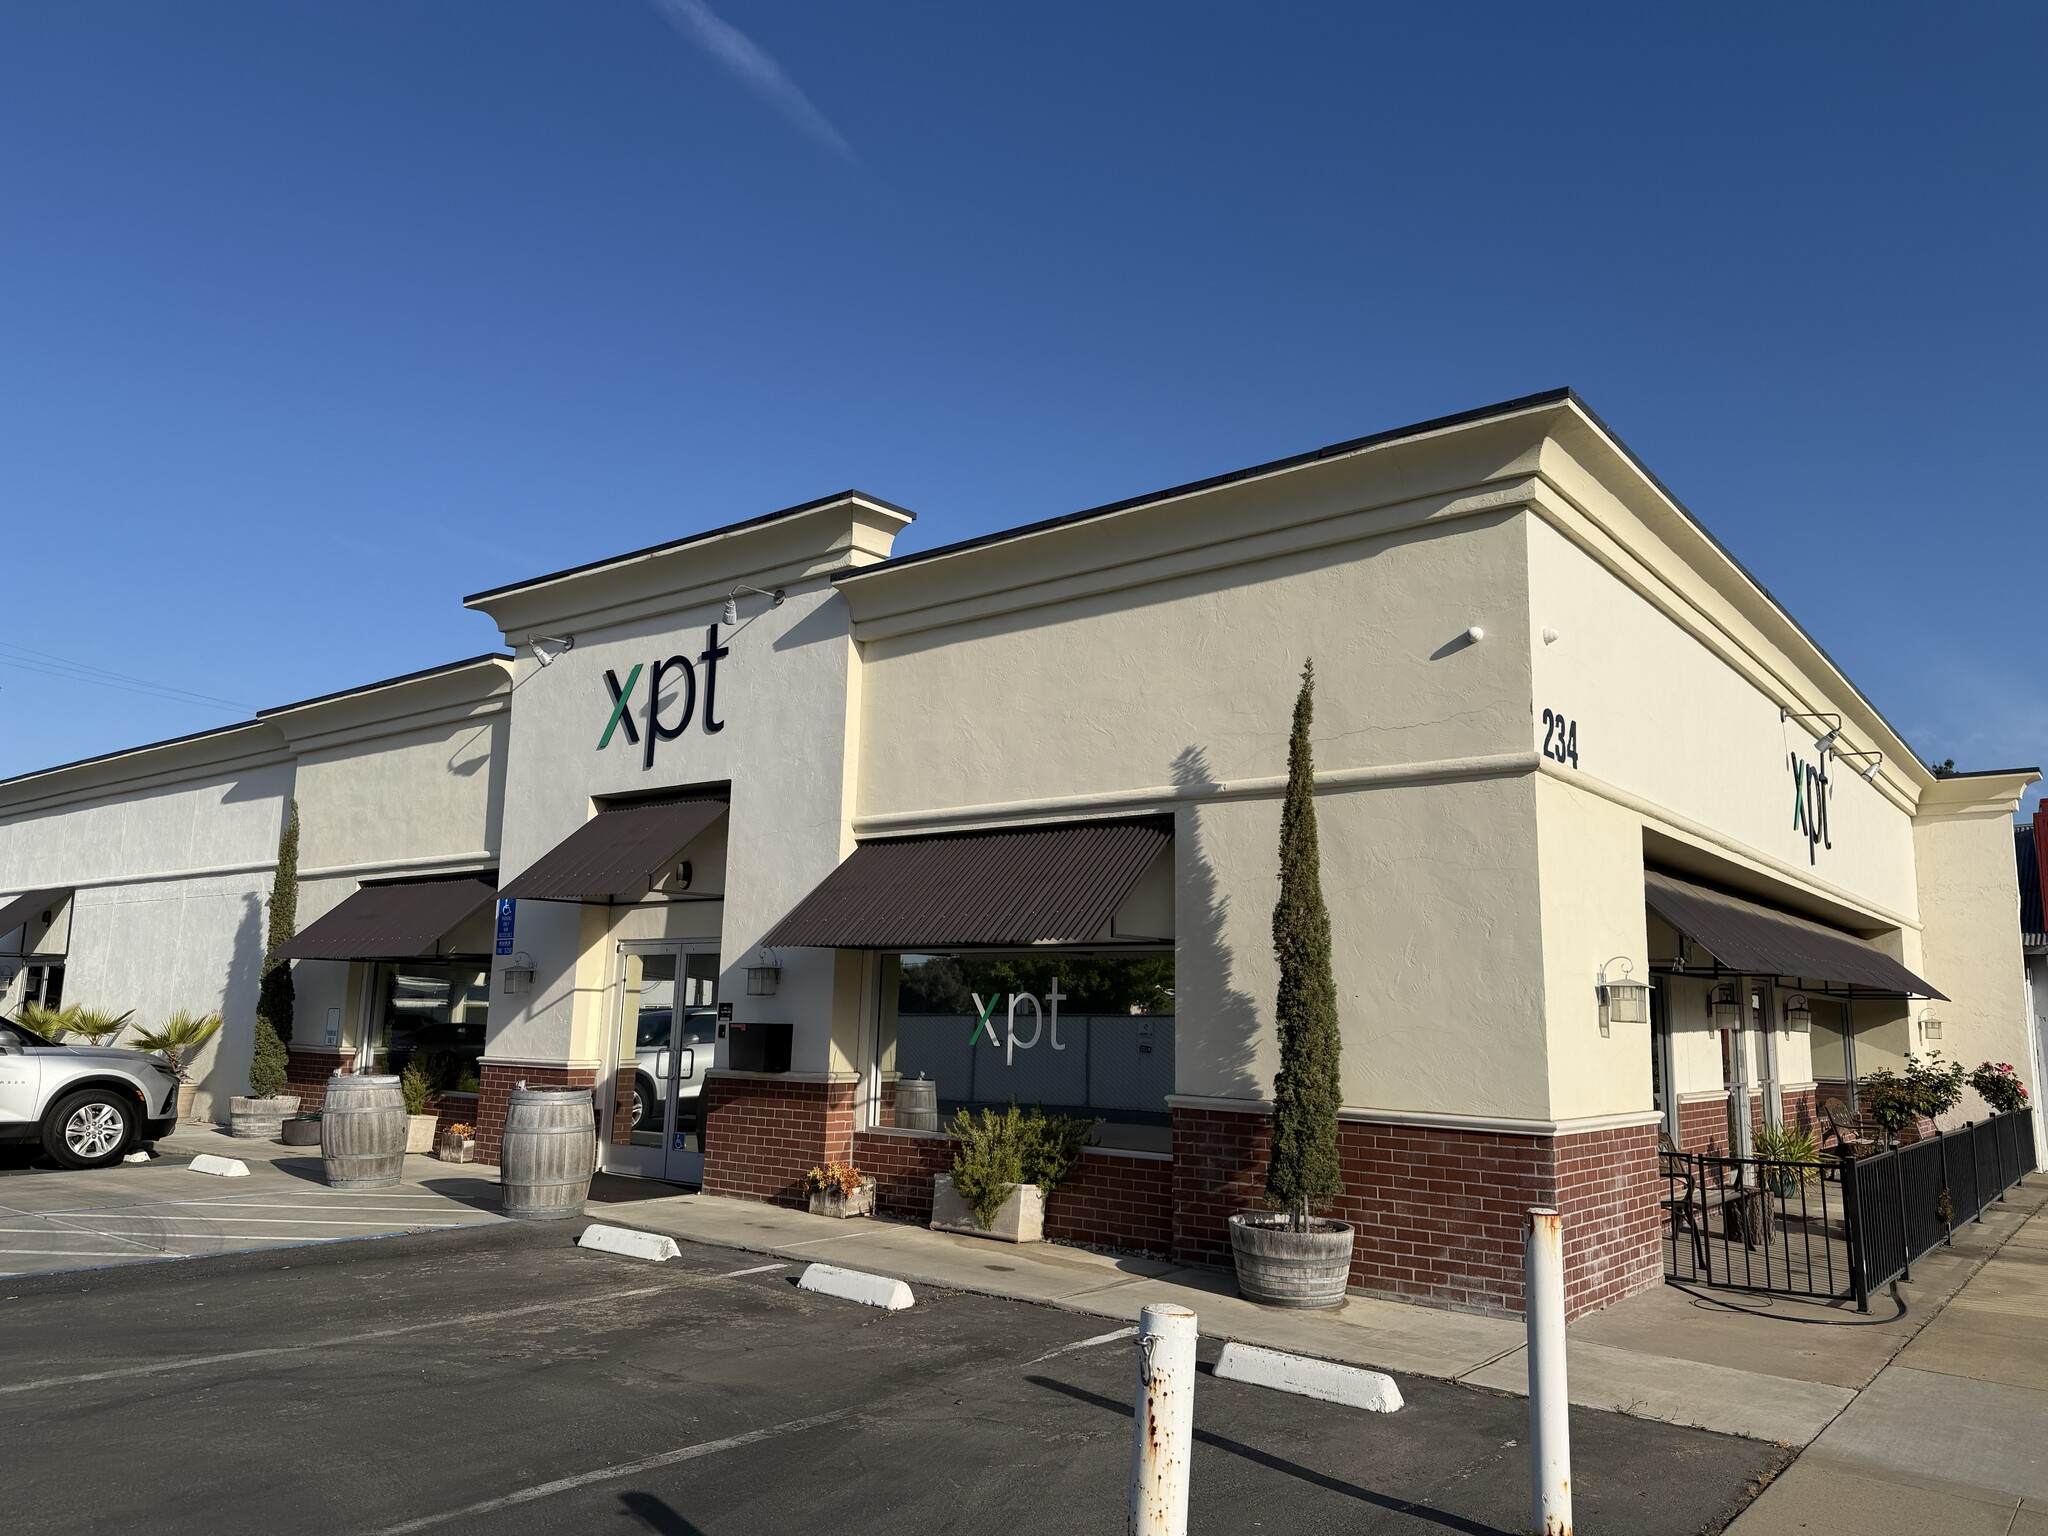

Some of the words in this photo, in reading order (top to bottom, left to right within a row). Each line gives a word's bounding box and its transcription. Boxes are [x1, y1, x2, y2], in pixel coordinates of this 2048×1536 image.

[596, 623, 729, 768] xpt
[1543, 708, 1578, 770] 234
[1791, 752, 1831, 866] xpt
[968, 977, 1067, 1066] xpt
